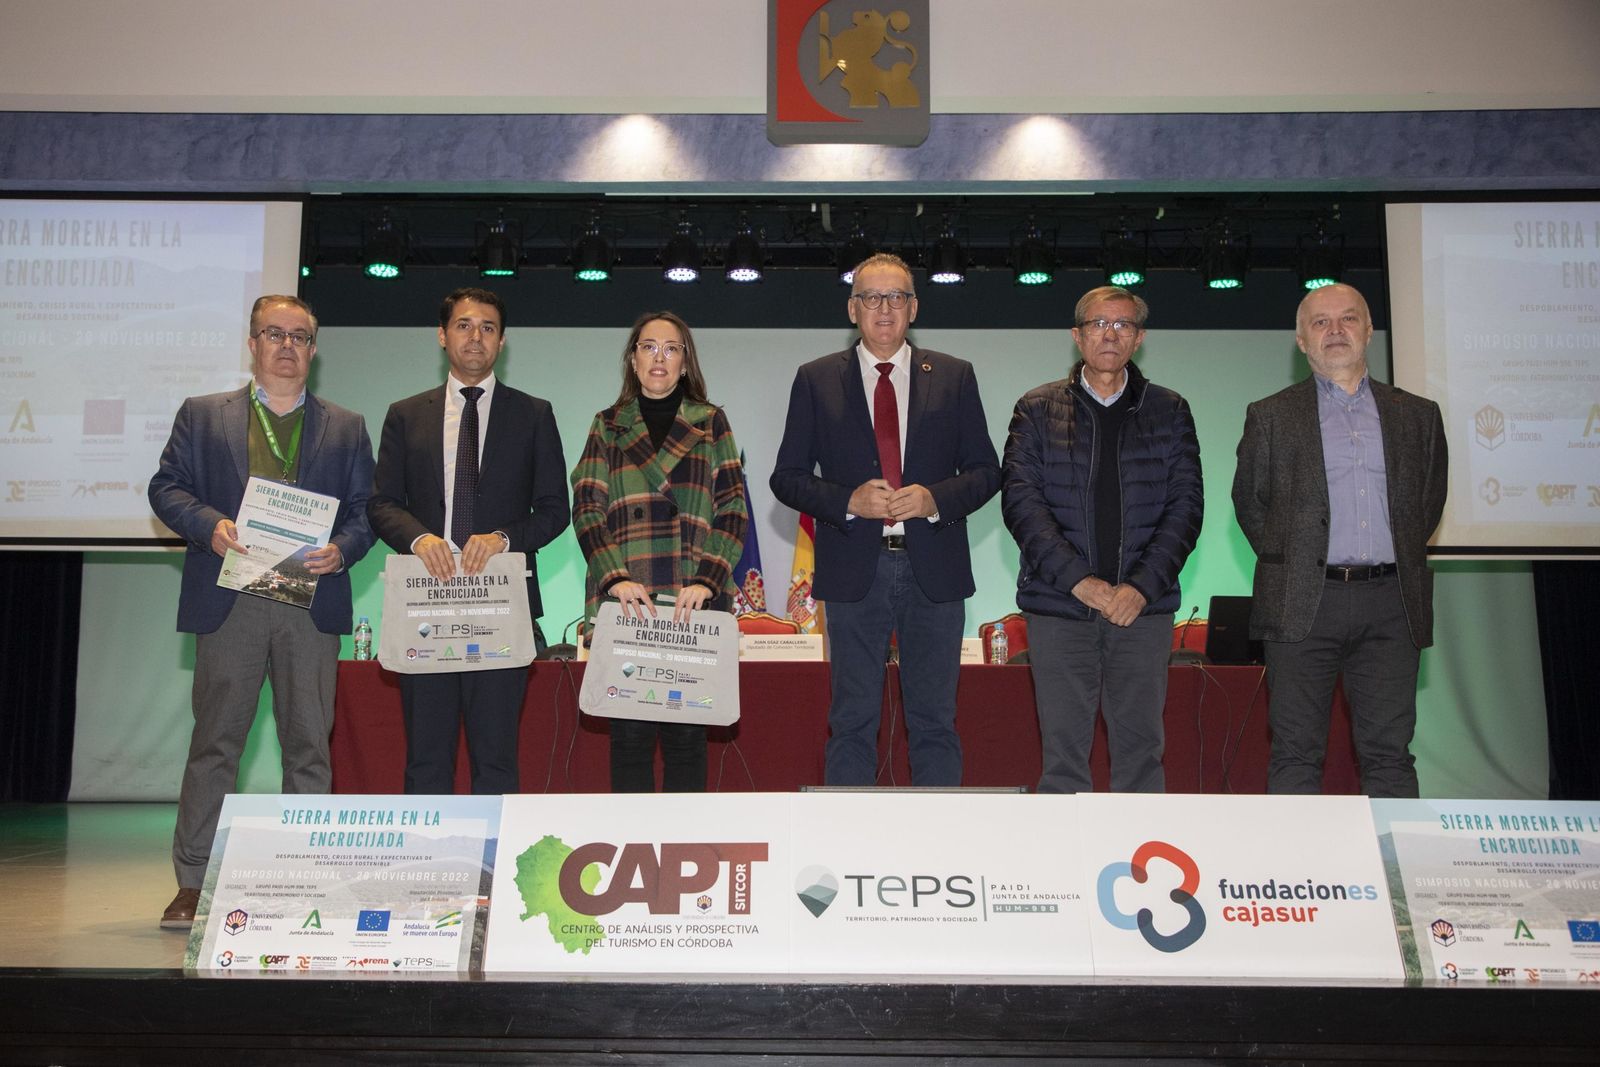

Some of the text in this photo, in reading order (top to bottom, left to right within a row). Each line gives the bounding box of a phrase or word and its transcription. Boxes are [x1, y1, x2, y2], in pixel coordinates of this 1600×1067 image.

[41, 219, 182, 248] MORENA EN LA
[1513, 220, 1585, 248] SIERRA
[5, 258, 136, 288] ENCRUCIJADA
[190, 331, 226, 347] 2022
[1463, 334, 1538, 350] SIMPOSIO
[255, 485, 329, 512] SIERRA MORENA EN LA
[267, 497, 312, 517] ENCRUCIJADA
[406, 575, 509, 589] SIERRA MORENA EN LA
[427, 587, 489, 600] ENCRUCIJADA
[496, 607, 510, 615] 2022
[616, 615, 720, 637] SIERRA MORENA EN LA
[635, 629, 698, 646] ENCRUCIJADA
[281, 809, 440, 826] SIERRA MORENA EN LA
[1440, 814, 1600, 833] SIERRA MORENA EN L
[309, 831, 404, 848] ENCRUCIJADA
[1479, 837, 1581, 856] ENCRUCIJADA
[231, 869, 470, 882] SIMPOSIO NACIONAL NOVIEMBRE 2022
[558, 841, 769, 917] CAPT
[1415, 877, 1470, 888] SIMPOSIO
[1475, 878, 1532, 889] NACIONAL
[734, 863, 747, 911] SITCOR
[844, 874, 976, 908] TePS
[1218, 878, 1378, 900] fundaciones
[1033, 892, 1081, 900] ANDALUCÍA
[1222, 901, 1318, 927] cajasur
[403, 922, 430, 931] Andalucía
[438, 930, 458, 939] Europa
[561, 922, 759, 934] CENTRO DE ANÁLISIS Y PROSPECTIVA
[585, 935, 733, 948] DEL TURISMO EN CÓRDOBA
[264, 955, 290, 965] CAPT
